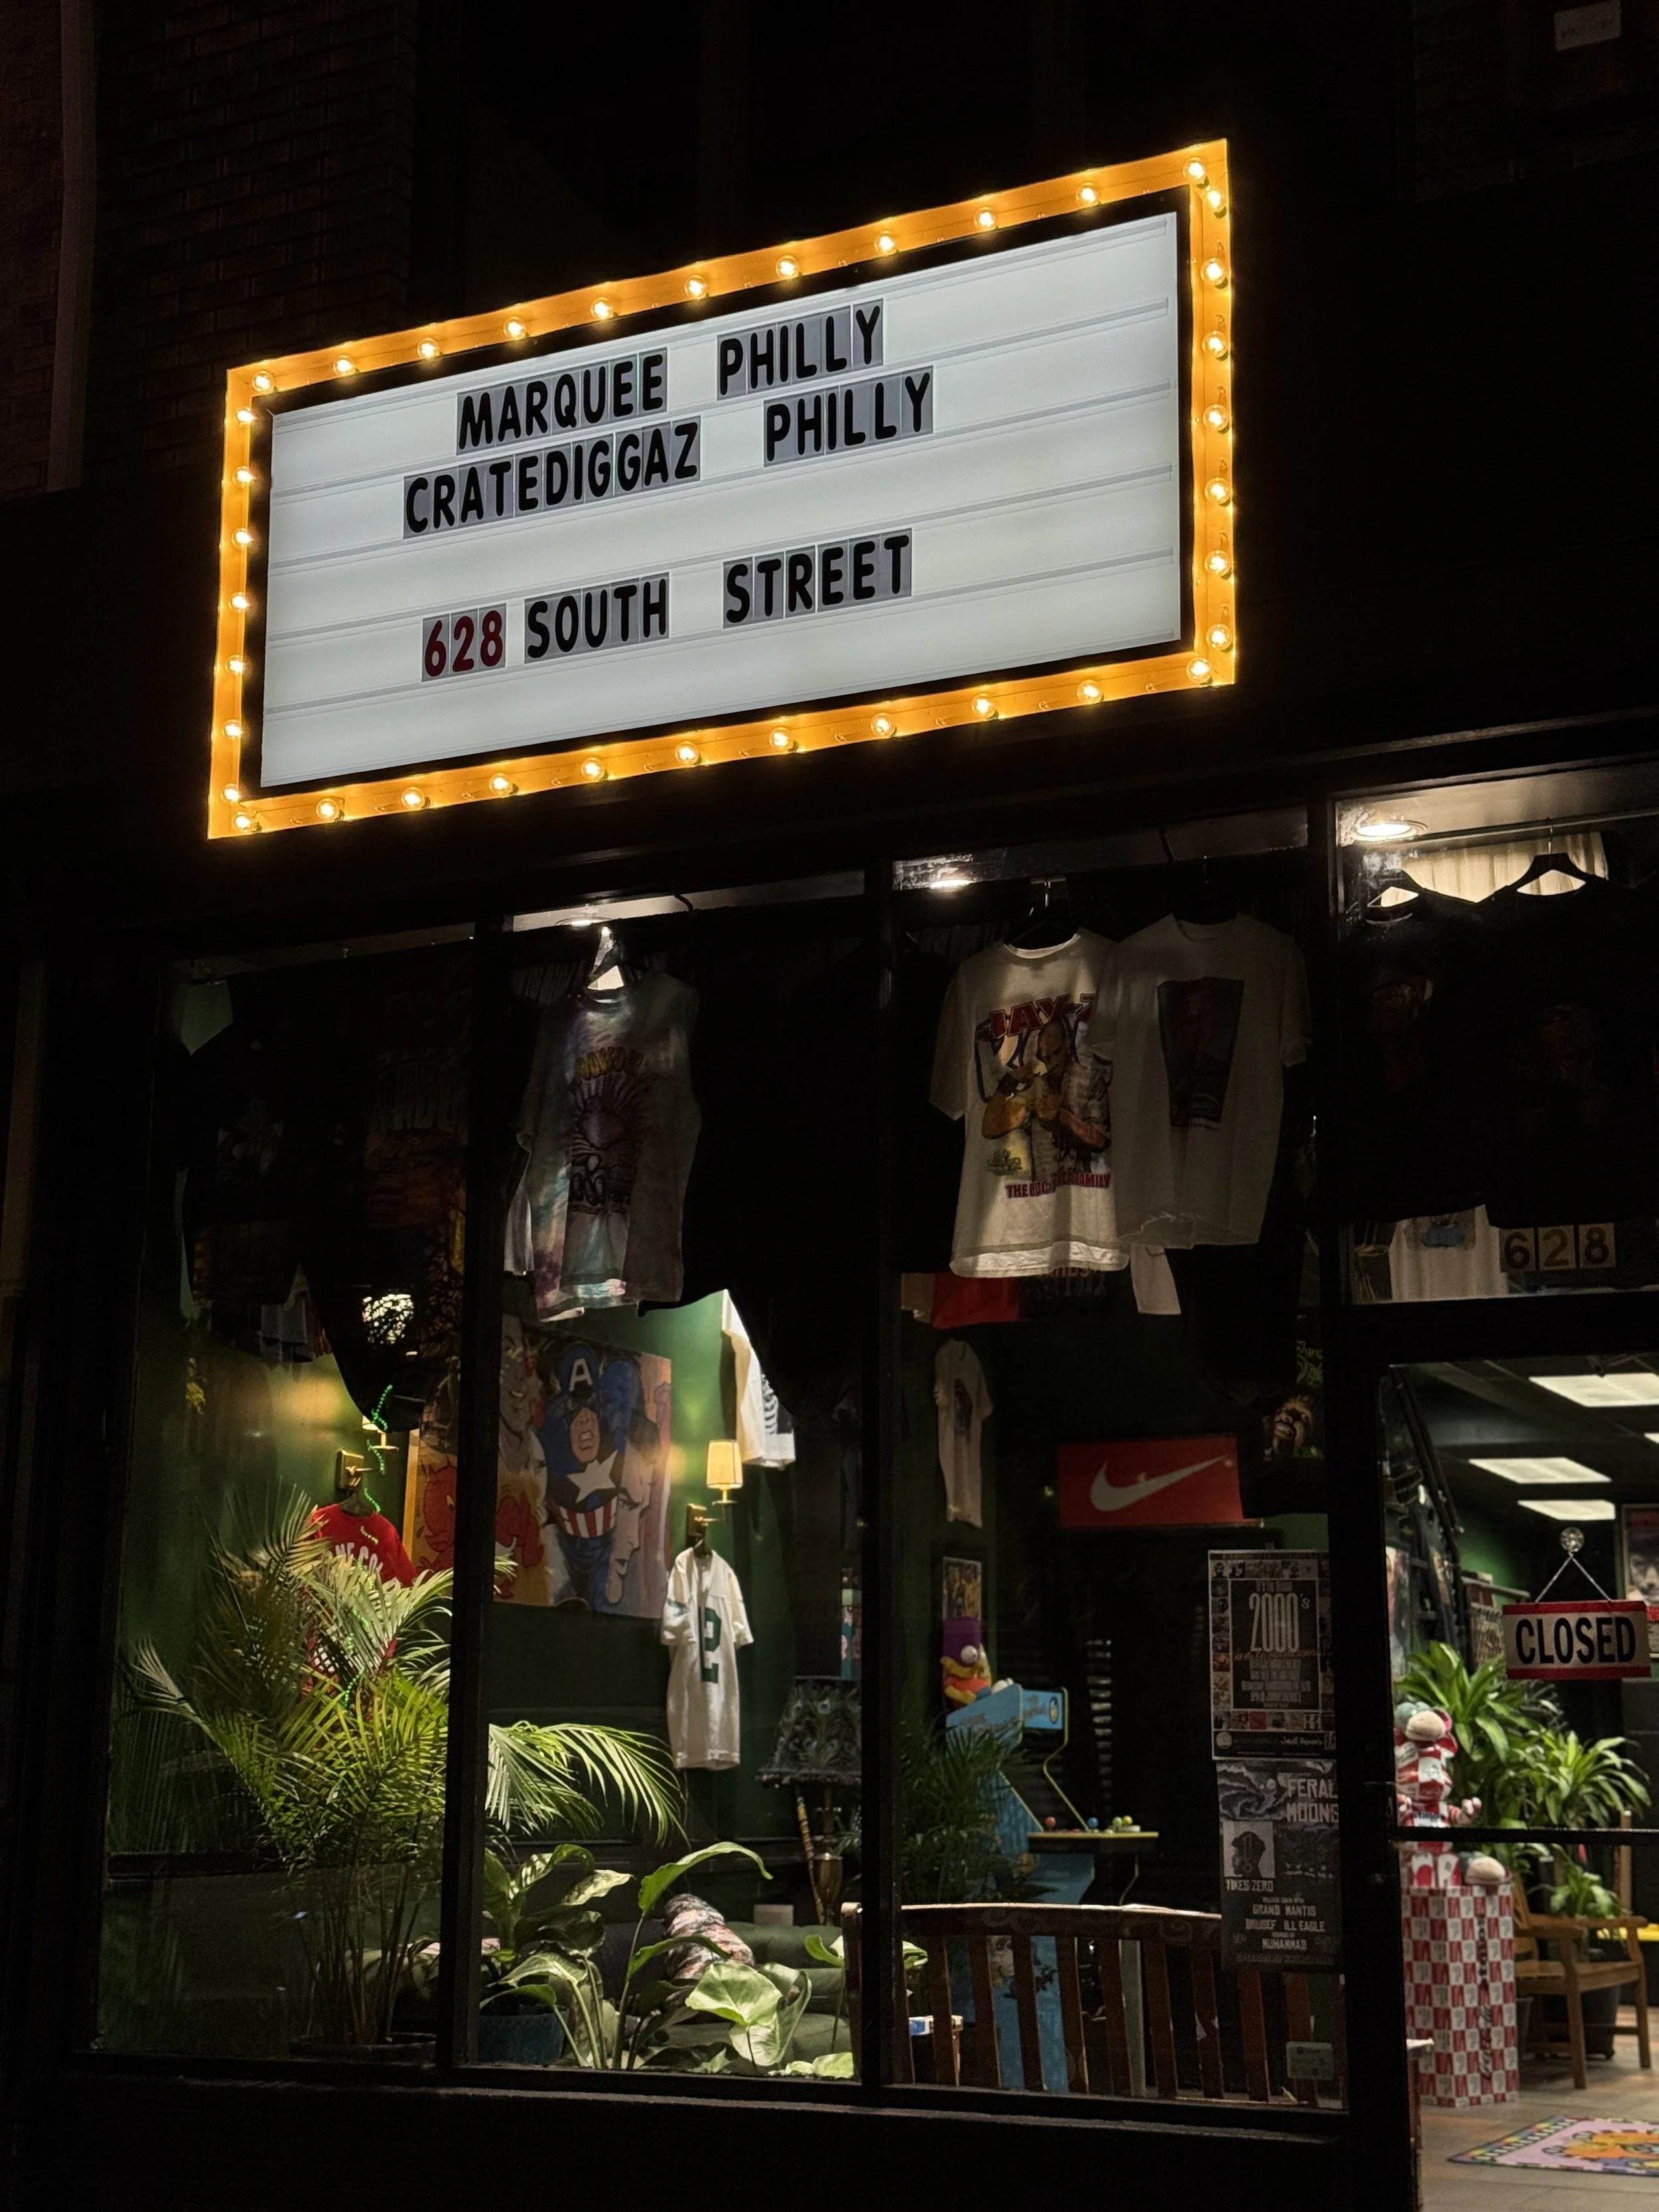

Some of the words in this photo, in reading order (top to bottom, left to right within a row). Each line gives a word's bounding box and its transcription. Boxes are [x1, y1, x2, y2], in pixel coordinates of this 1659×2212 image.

[459, 354, 664, 449] MARQUEE
[720, 305, 881, 396] PHILLY
[405, 421, 698, 534] CRATEDIGGAZ
[766, 372, 930, 461] PHILLY
[425, 610, 504, 678] 628
[528, 577, 667, 659] SOUTH
[726, 535, 910, 624] STREET
[1504, 1227, 1609, 1269] 628
[569, 1358, 593, 1392] A
[1516, 1617, 1636, 1664] CLOSED
[1287, 1779, 1338, 1799] FERAL
[1286, 1802, 1339, 1824] MOONS
